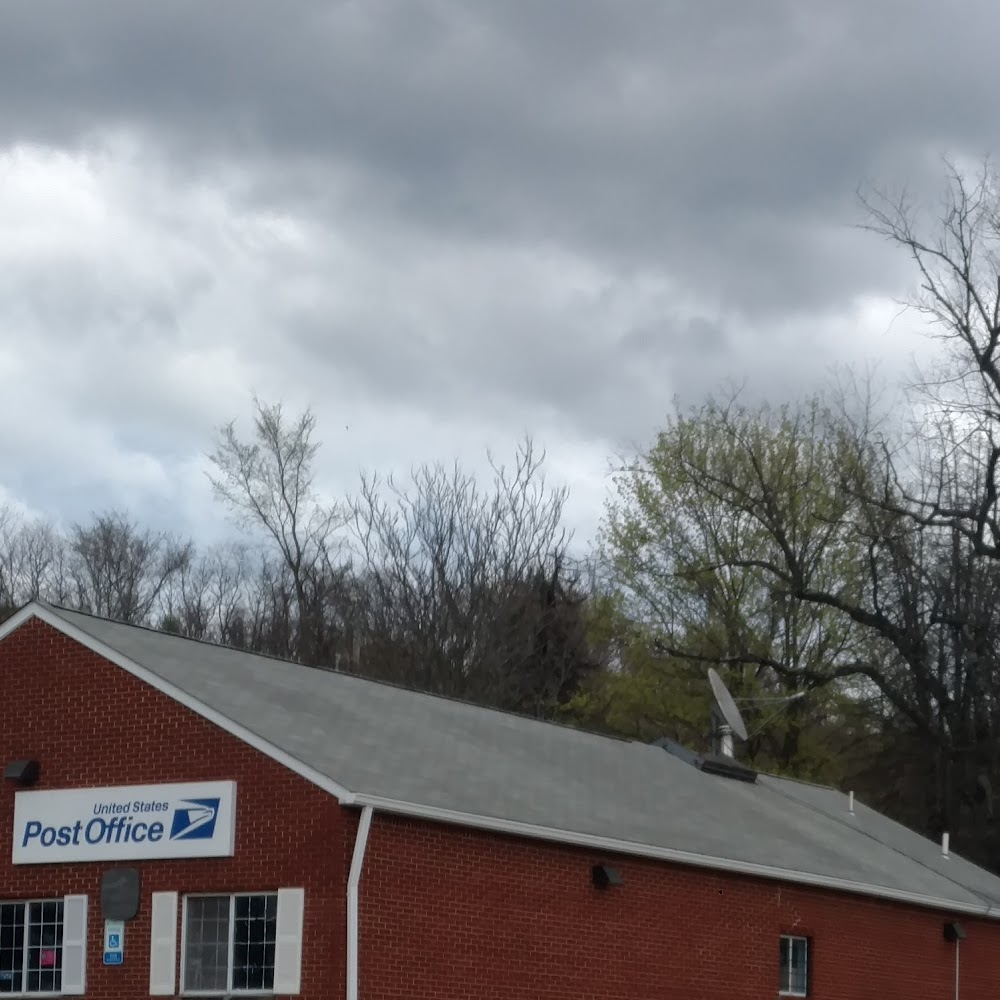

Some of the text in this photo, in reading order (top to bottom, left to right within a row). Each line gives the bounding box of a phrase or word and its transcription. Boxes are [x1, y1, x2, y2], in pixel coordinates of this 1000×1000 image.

[93, 800, 169, 815] United States
[22, 816, 164, 848] Post Office
